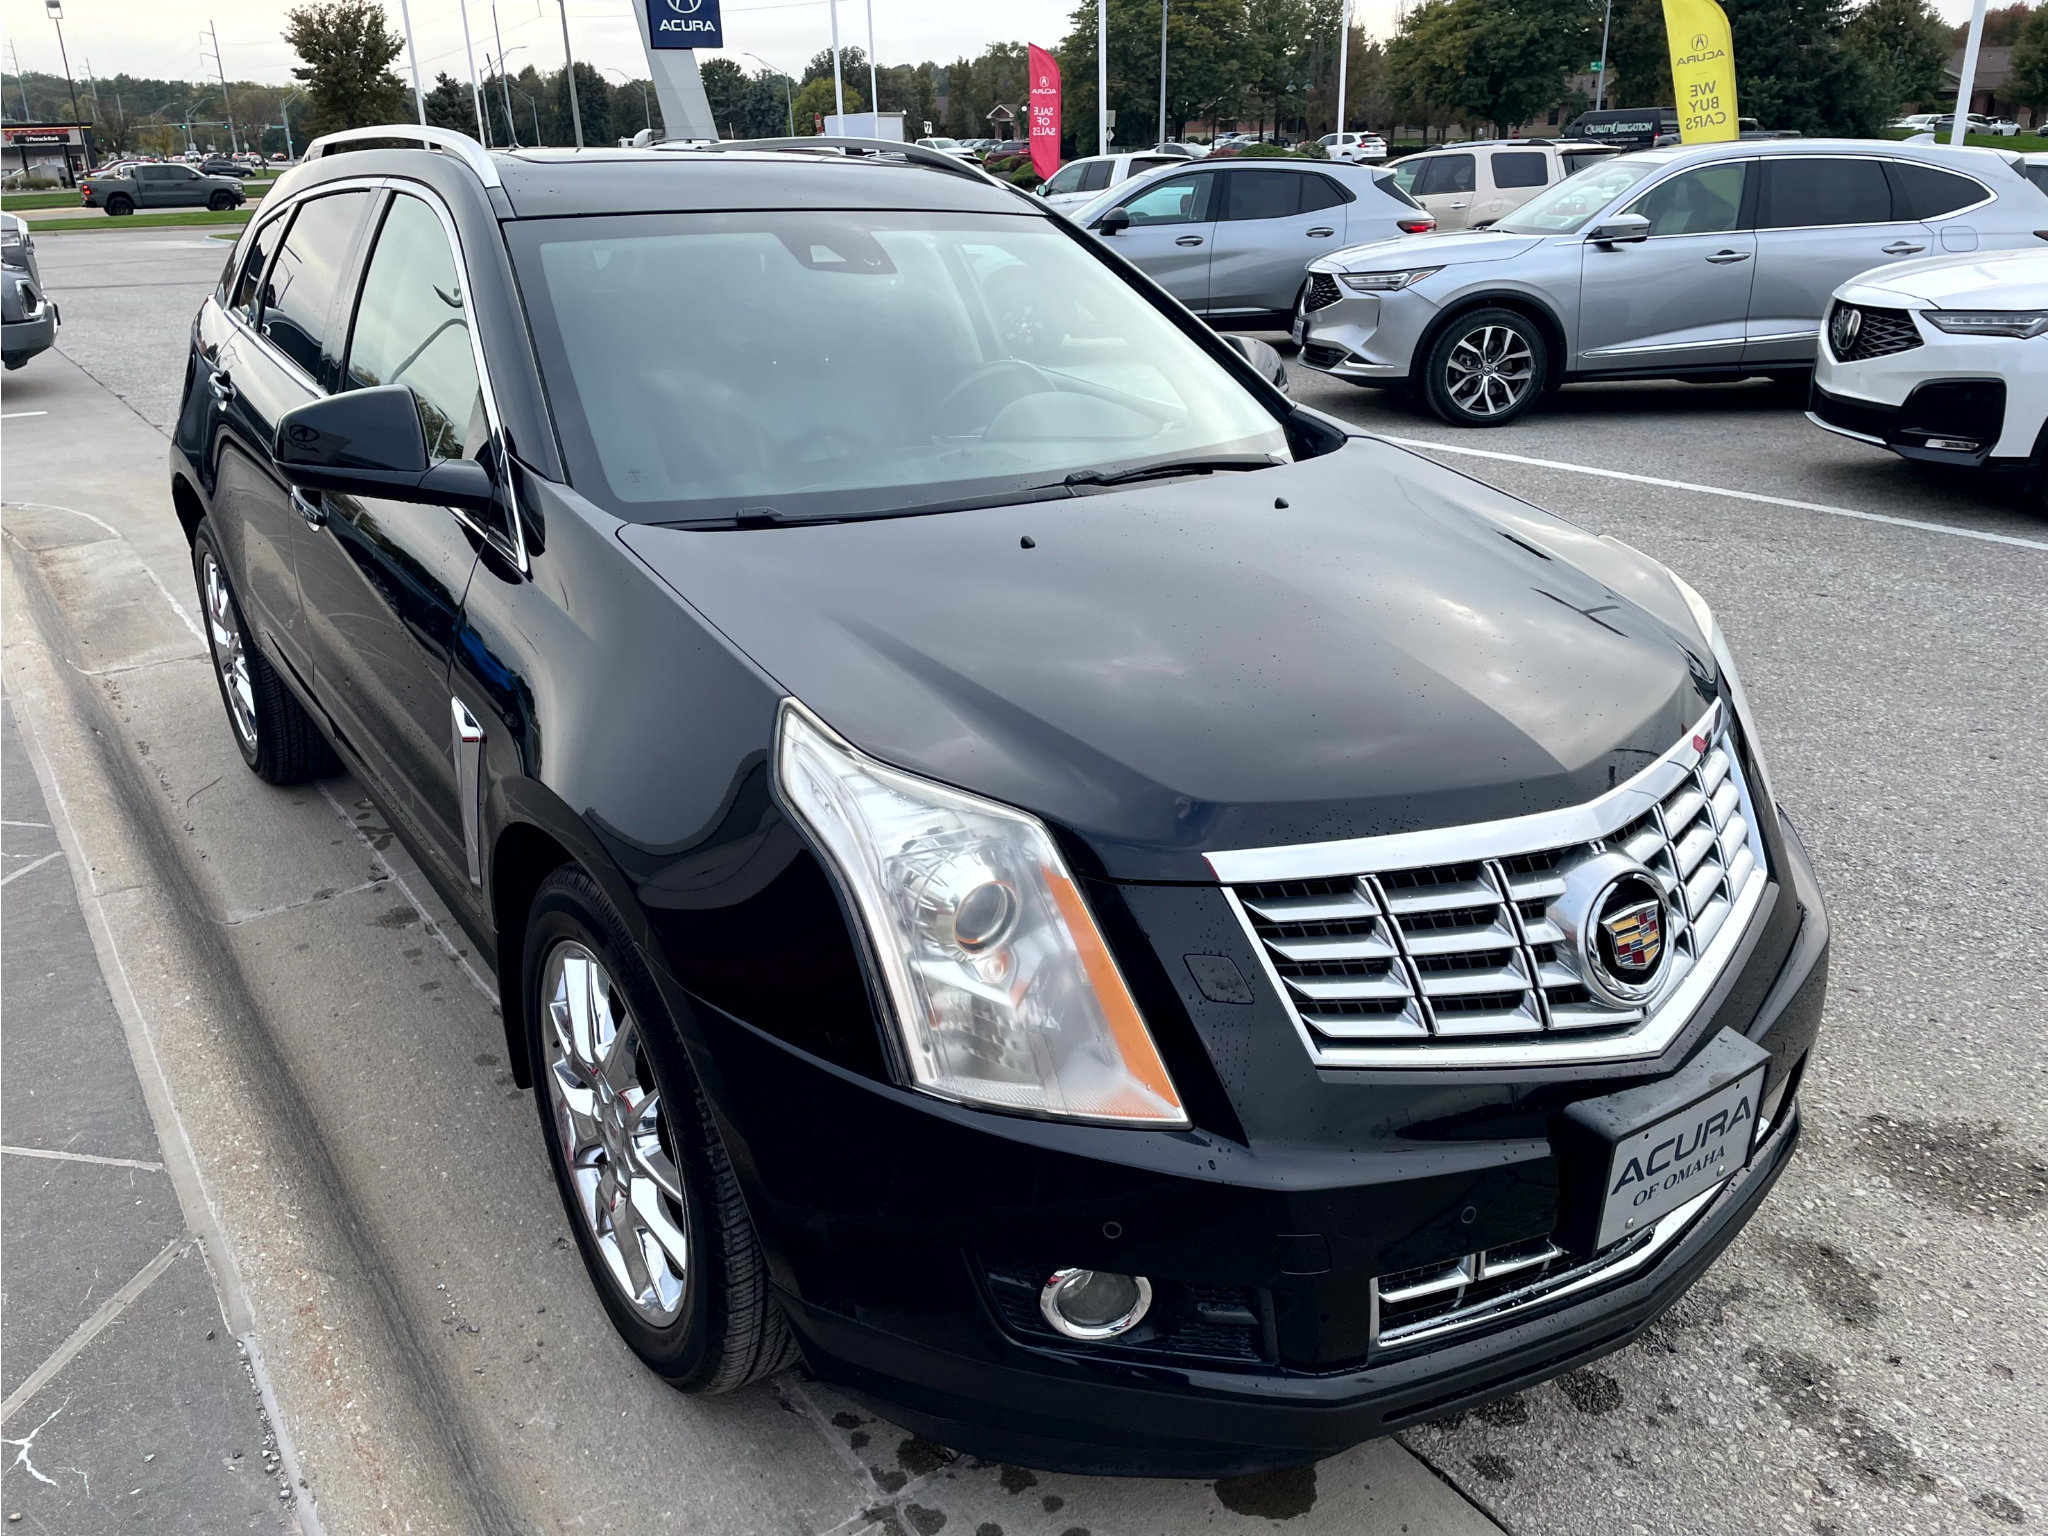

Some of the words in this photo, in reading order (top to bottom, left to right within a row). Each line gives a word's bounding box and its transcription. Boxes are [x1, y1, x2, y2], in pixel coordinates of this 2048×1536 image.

[659, 19, 716, 32] ACURA
[1611, 1095, 1751, 1196] ACURA
[1632, 1181, 1660, 1208] OF
[1662, 1144, 1726, 1191] OMAHA
